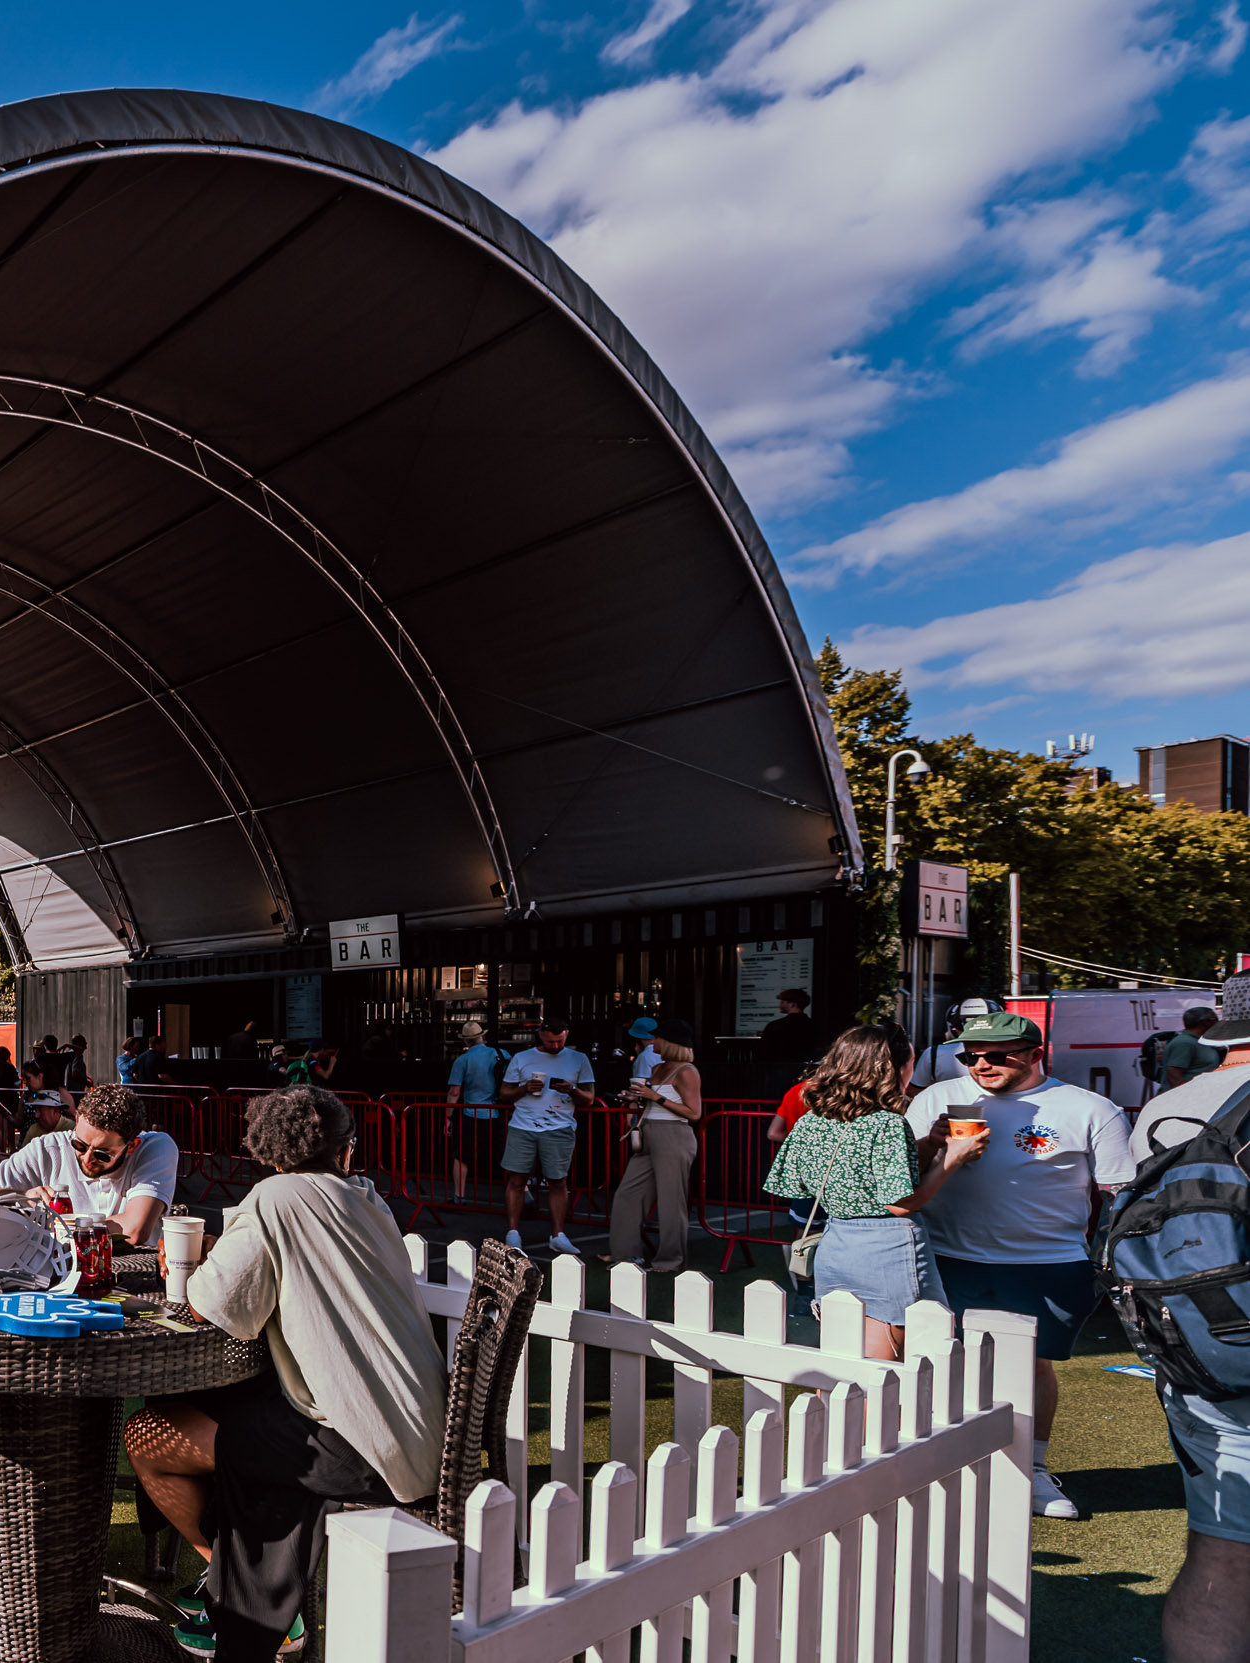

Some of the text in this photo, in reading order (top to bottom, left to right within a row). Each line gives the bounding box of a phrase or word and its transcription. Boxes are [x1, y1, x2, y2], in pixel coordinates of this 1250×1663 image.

[938, 872, 949, 885] THE
[924, 894, 962, 925] BAR
[356, 922, 370, 933] THE
[339, 938, 392, 961] BAR
[756, 939, 794, 953] BAR
[1129, 999, 1160, 1031] THE
[1018, 1125, 1037, 1135] HOT
[1037, 1125, 1060, 1139] CHILI
